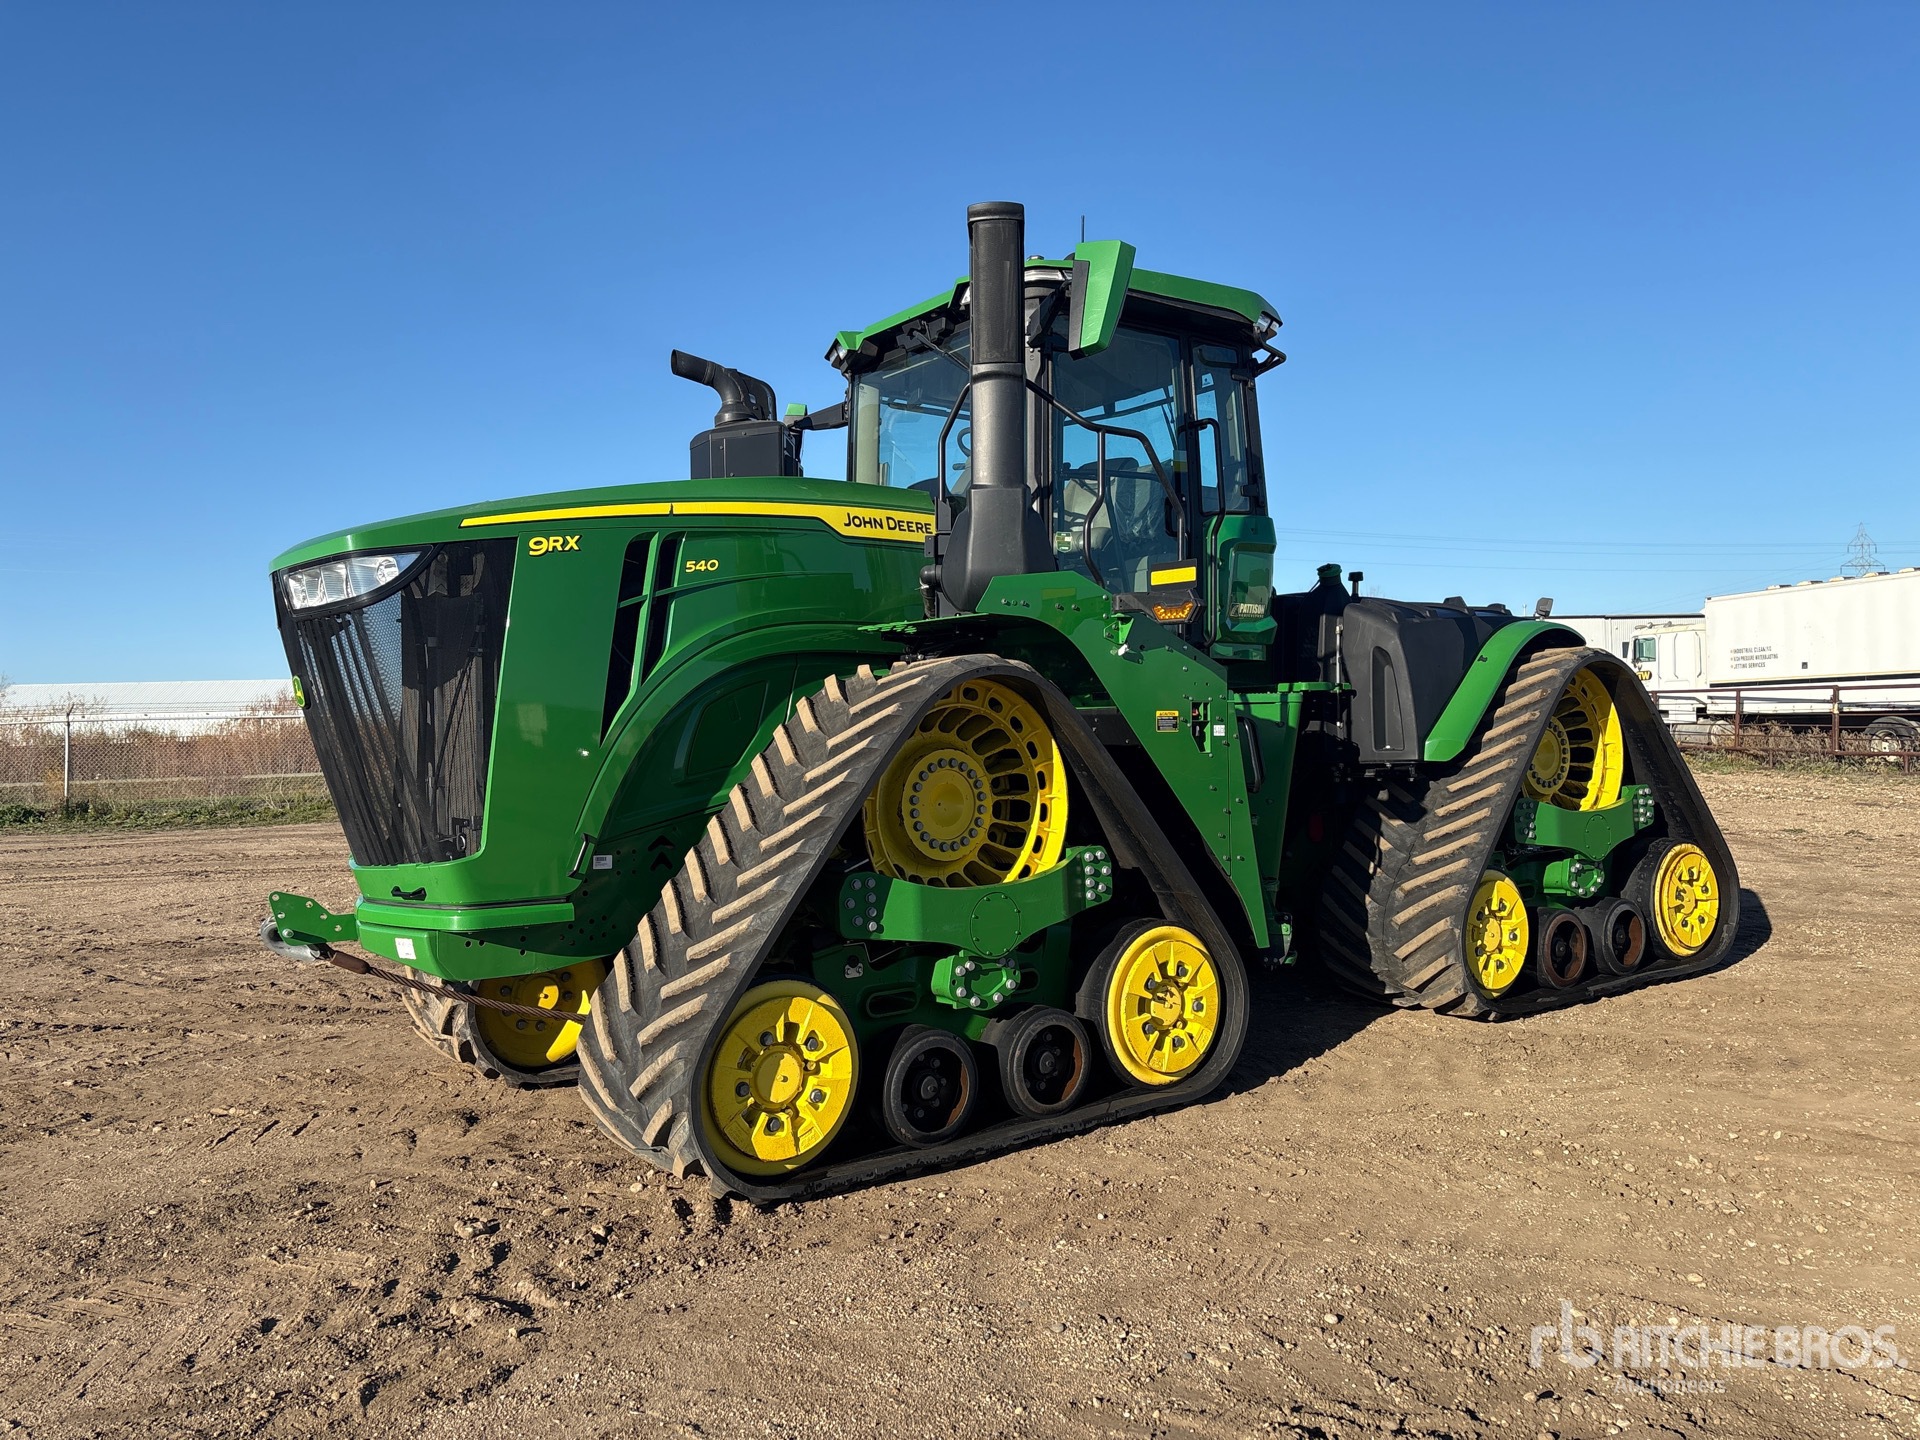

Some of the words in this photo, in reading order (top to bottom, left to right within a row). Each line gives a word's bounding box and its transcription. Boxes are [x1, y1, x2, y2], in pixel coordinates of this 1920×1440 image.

[843, 512, 884, 530] JOHN
[885, 516, 933, 534] DEERE
[528, 535, 581, 556] 9RX
[685, 559, 719, 573] 540
[1240, 603, 1265, 614] PATTISON
